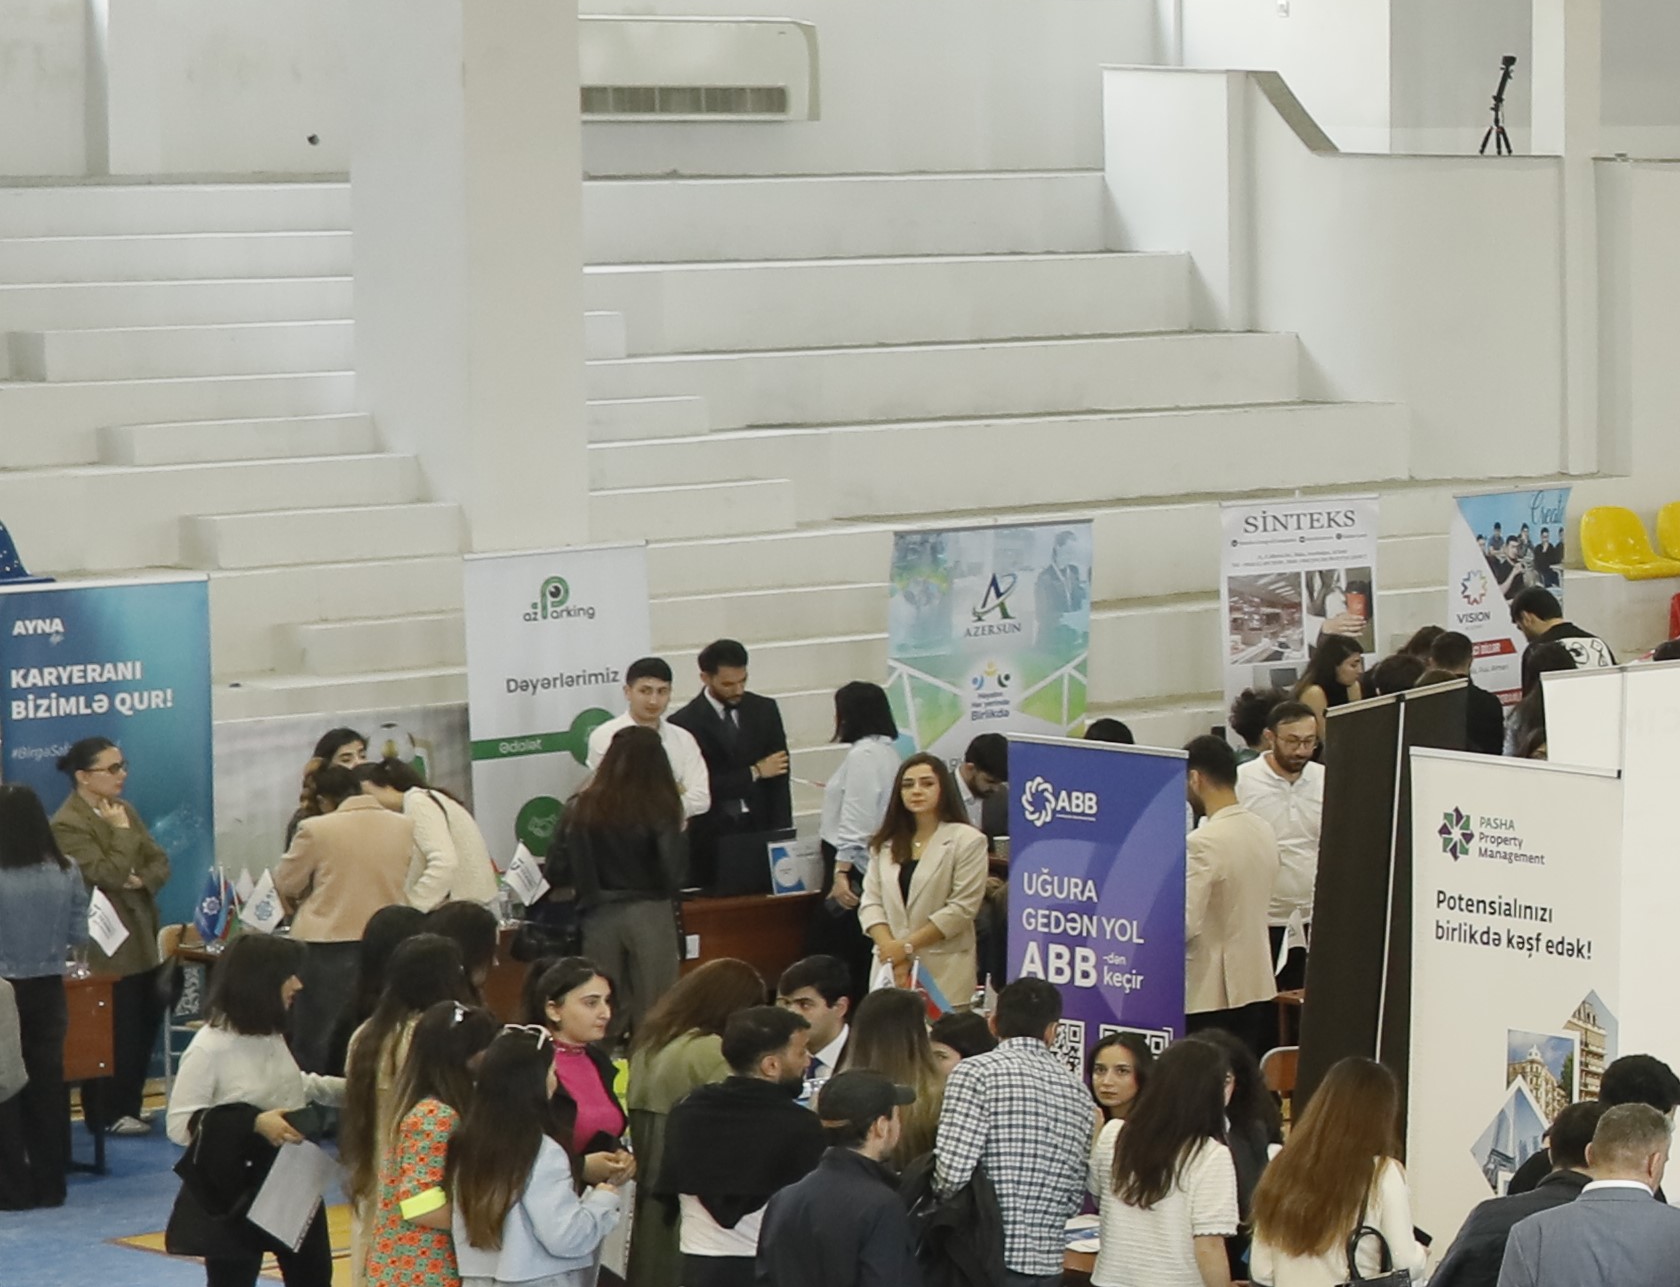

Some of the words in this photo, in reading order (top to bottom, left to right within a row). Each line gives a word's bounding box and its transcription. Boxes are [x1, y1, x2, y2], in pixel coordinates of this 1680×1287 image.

[1243, 510, 1355, 533] SİNTEKS
[12, 618, 64, 636] AYNA
[964, 622, 1021, 638] AZERSUN
[1447, 612, 1490, 624] VISION
[11, 661, 143, 689] KARYERANI
[507, 668, 619, 696] Dəyərlərimiz
[11, 693, 110, 720] BİZİMLƏ
[114, 688, 173, 716] QUR!
[1056, 790, 1097, 814] ABB
[1480, 817, 1515, 831] PASHA
[1479, 832, 1523, 850] Property
[1478, 847, 1545, 865] Management
[1023, 868, 1098, 902] UĞURA
[1436, 890, 1552, 923] Potensialınızı
[1022, 908, 1097, 938] GEDƏN
[1101, 916, 1144, 944] YOL
[1435, 920, 1501, 947] birlikdə
[1506, 928, 1542, 958] kəşf
[1545, 936, 1592, 960] edək!
[1020, 941, 1097, 988] ABB
[1103, 966, 1144, 993] keçir
